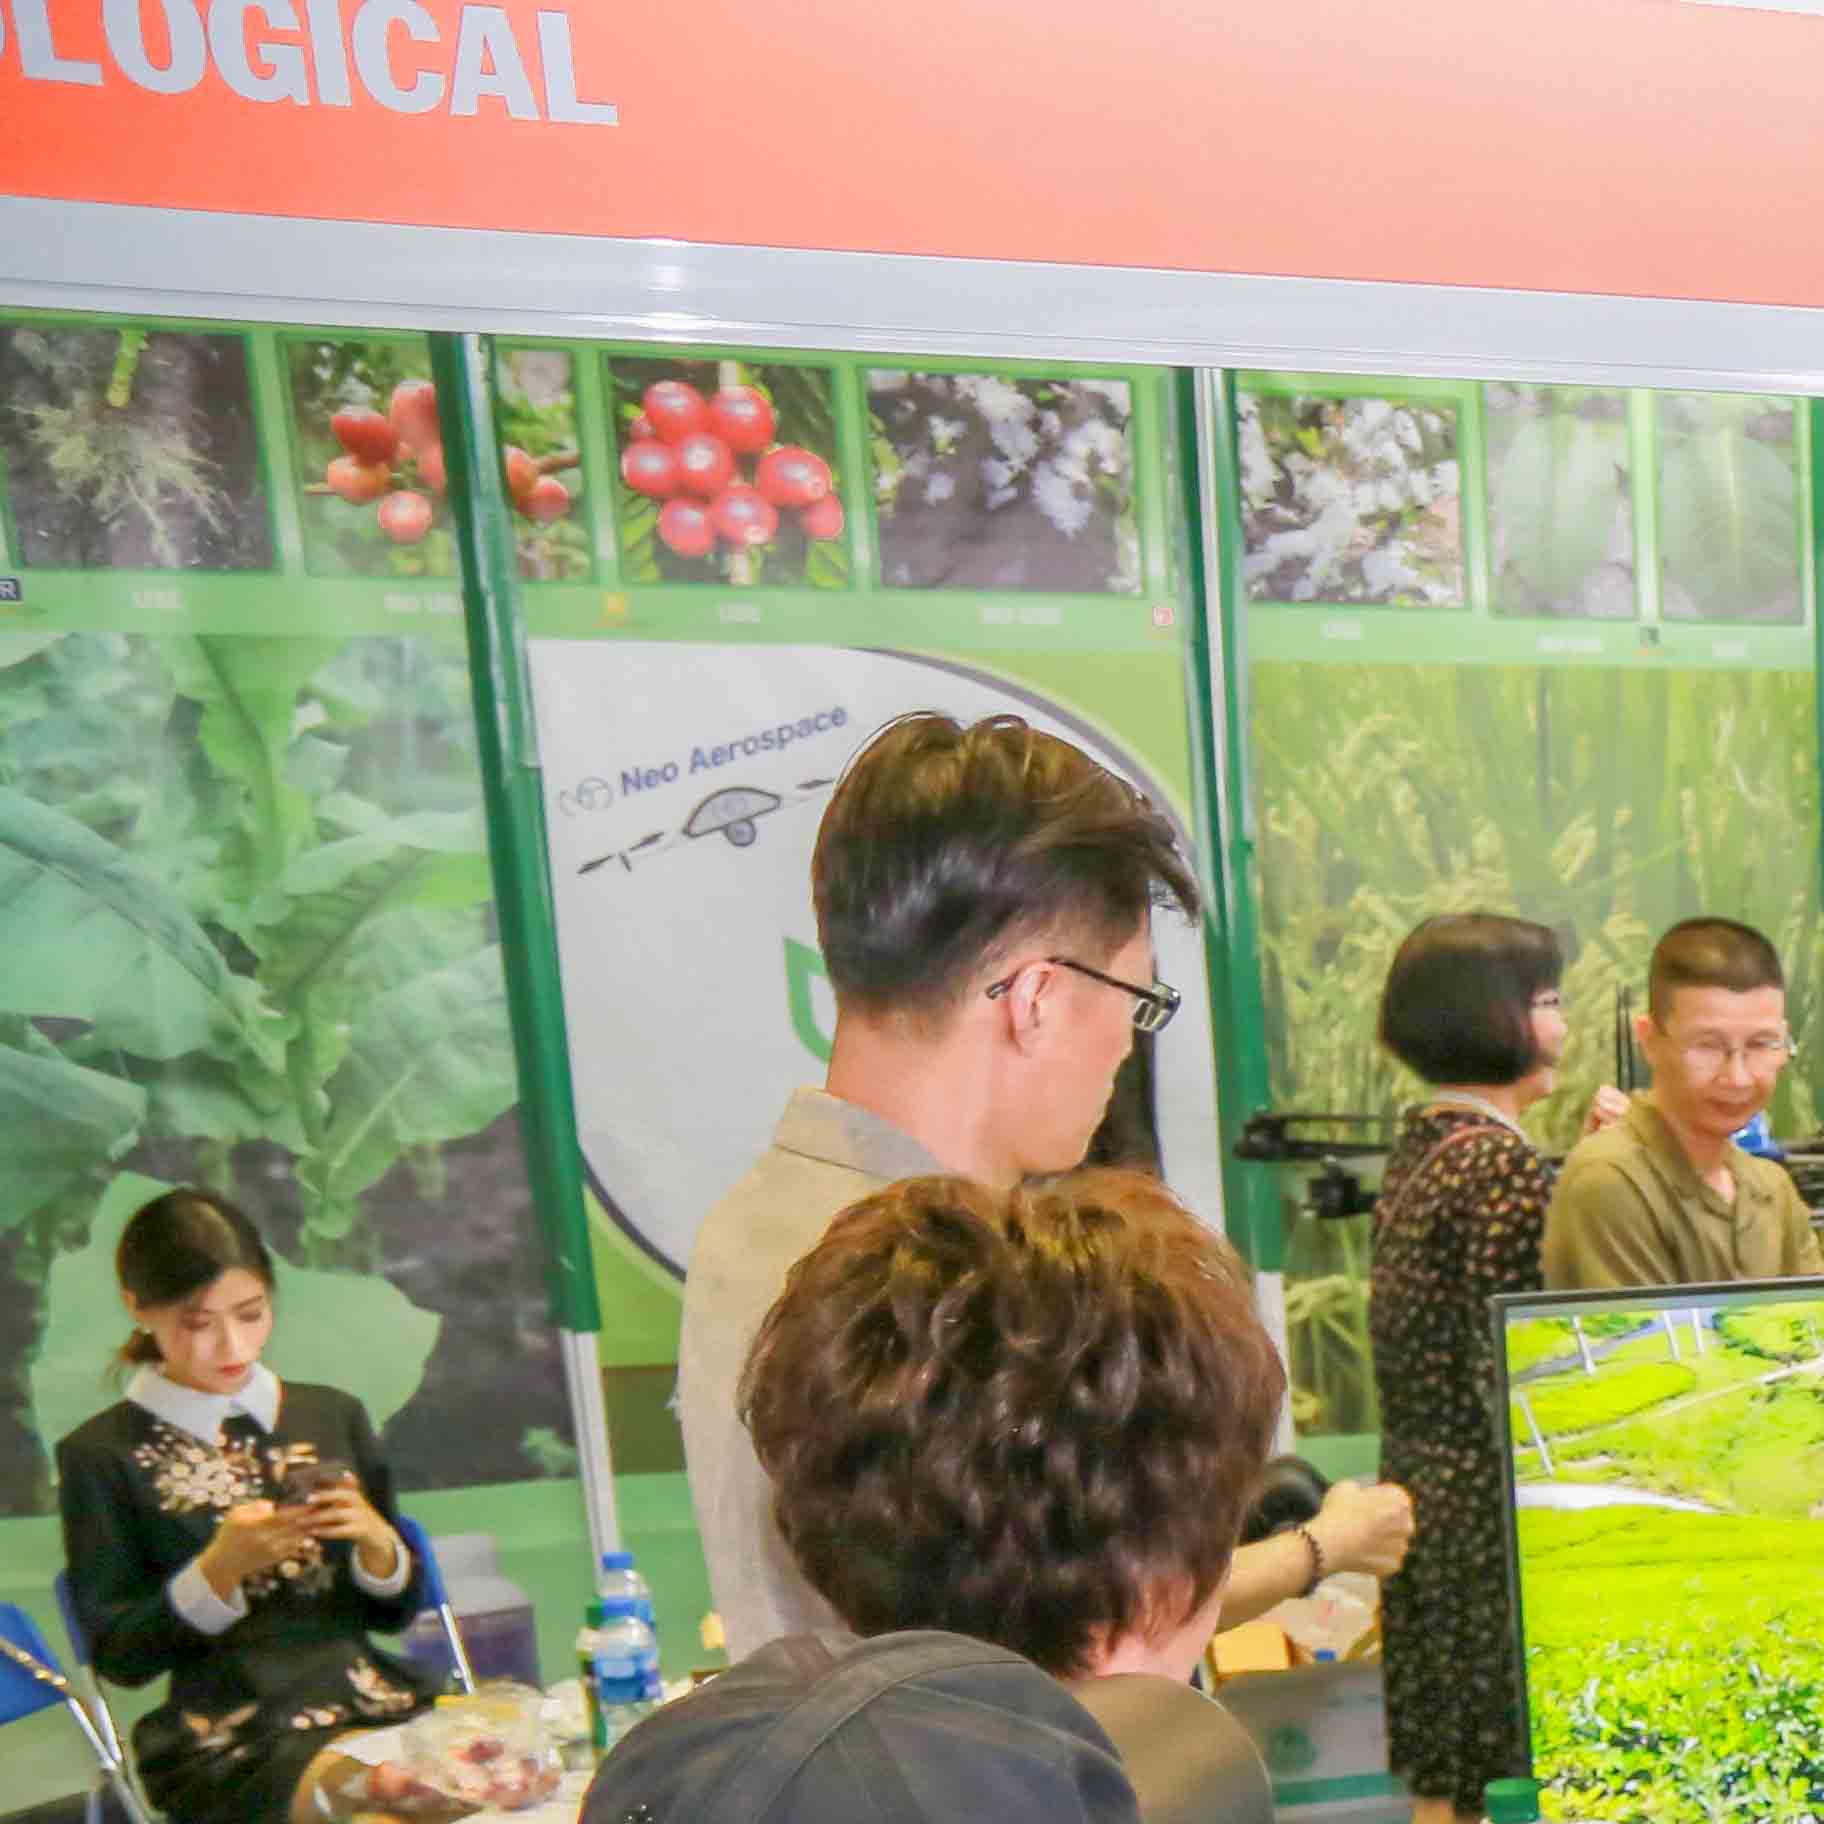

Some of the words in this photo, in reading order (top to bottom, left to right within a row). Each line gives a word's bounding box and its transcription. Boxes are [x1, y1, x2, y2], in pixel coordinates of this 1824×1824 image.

[0, 0, 619, 126] LOGICAL
[620, 760, 679, 797] Neo
[689, 706, 848, 775] Aerospace
